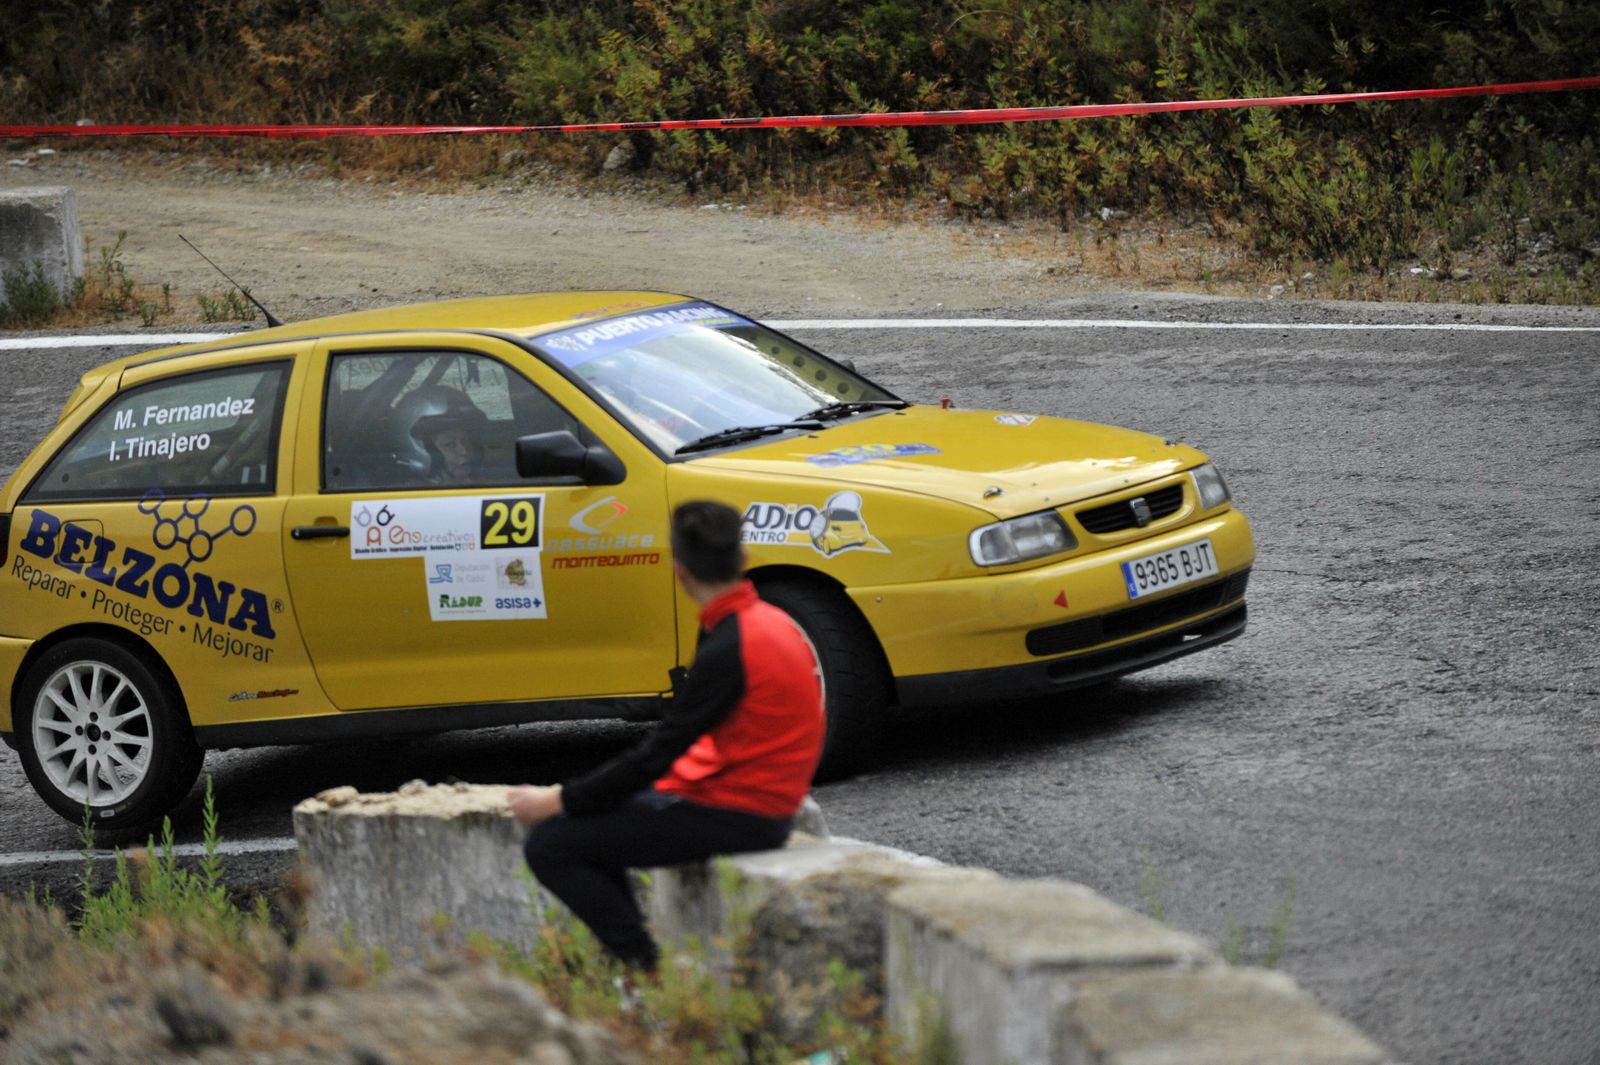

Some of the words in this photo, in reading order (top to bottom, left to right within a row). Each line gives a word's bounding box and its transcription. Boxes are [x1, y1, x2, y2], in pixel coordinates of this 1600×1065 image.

[575, 314, 659, 345] PUERTO
[114, 409, 137, 430] M.
[143, 396, 255, 426] Fernandez
[125, 432, 211, 460] Tinajero
[484, 500, 536, 546] 29
[740, 531, 787, 543] ENTRO
[20, 508, 276, 640] BELZONA
[1134, 554, 1180, 590] 9365
[1180, 543, 1213, 577] BJT
[12, 555, 76, 599] Reparar
[92, 589, 173, 635] Proteger
[193, 623, 274, 663] Mejorar
